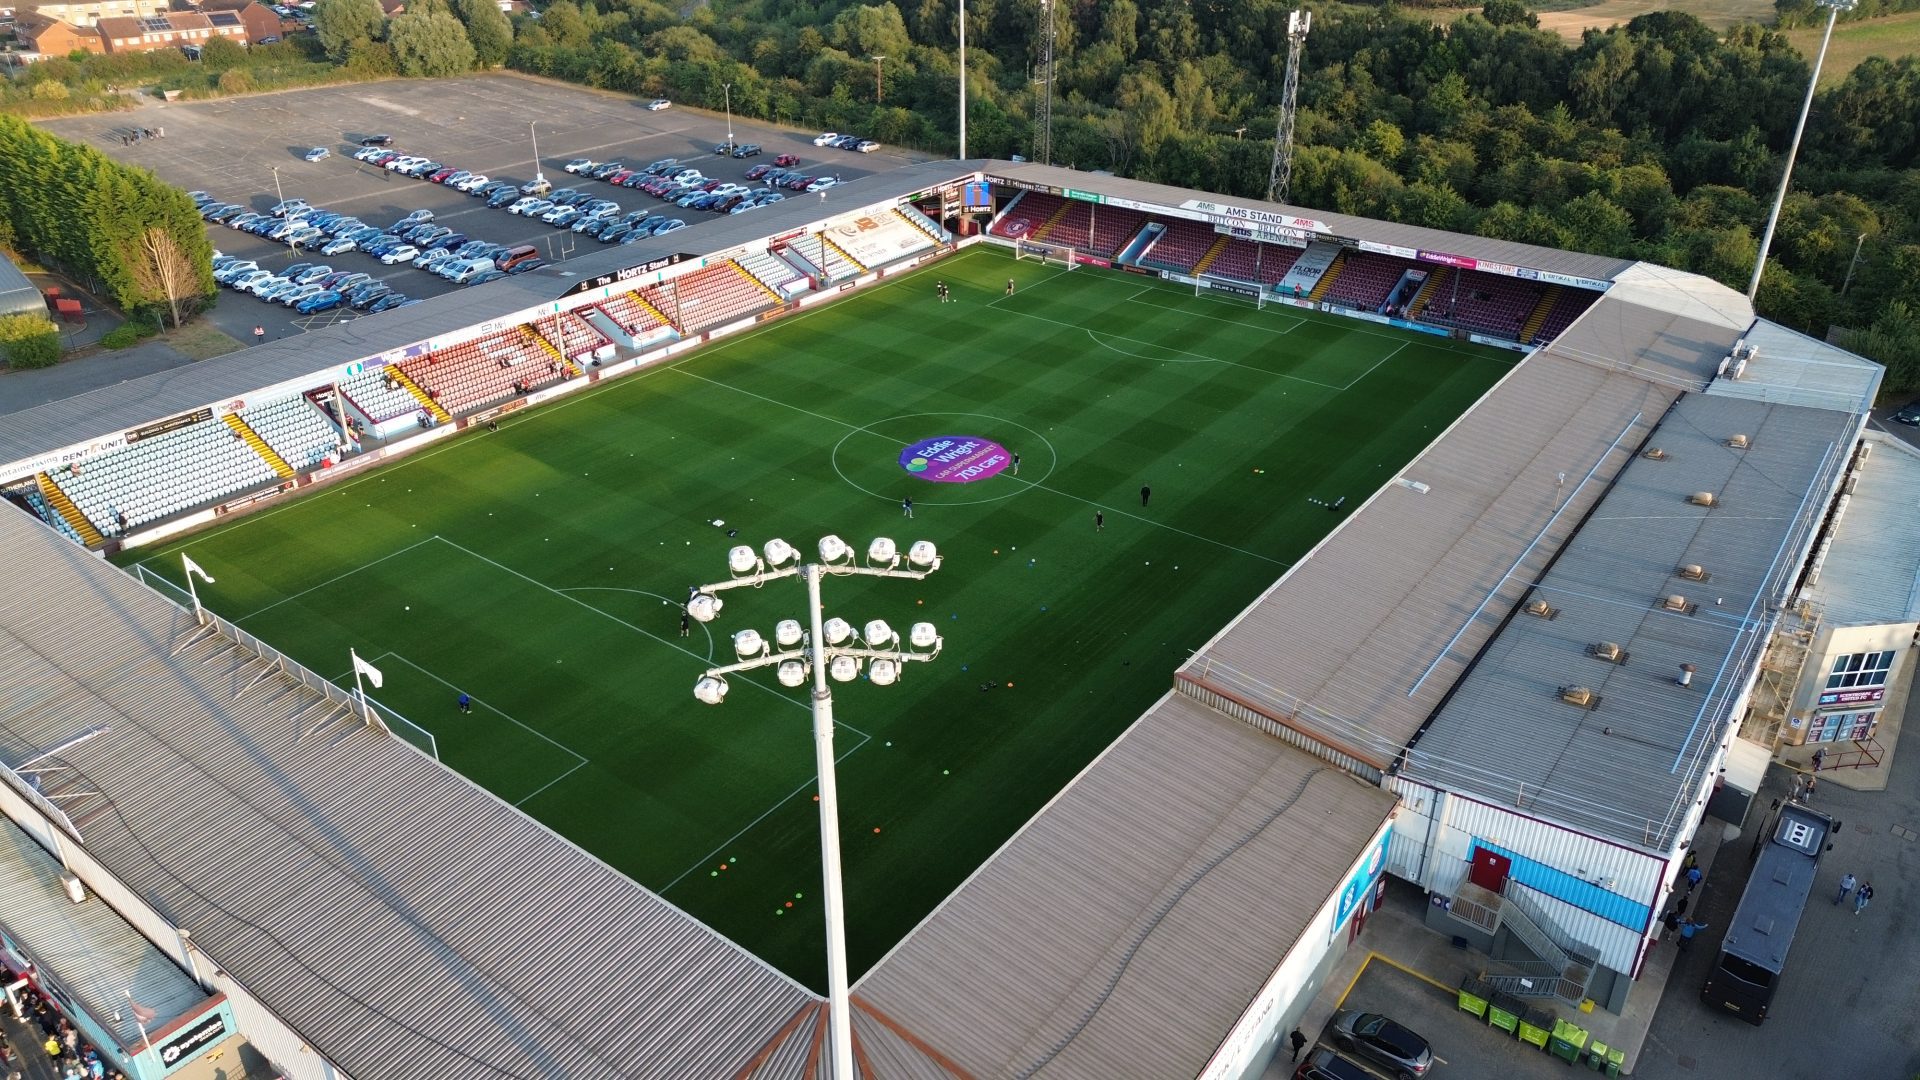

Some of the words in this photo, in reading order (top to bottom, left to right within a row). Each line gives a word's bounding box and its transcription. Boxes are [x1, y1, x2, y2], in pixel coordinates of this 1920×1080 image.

[1196, 202, 1216, 211] AMS
[1225, 207, 1248, 218] AMS
[1249, 210, 1283, 224] STAND
[1293, 218, 1314, 228] AMS
[1256, 230, 1289, 243] ARENA
[597, 276, 611, 286] The
[617, 264, 647, 280] HORTZ
[649, 258, 669, 272] Stand
[62, 448, 90, 462] RENT
[100, 438, 125, 450] UNIT
[917, 440, 955, 458] Eddie
[933, 441, 981, 463] Wright
